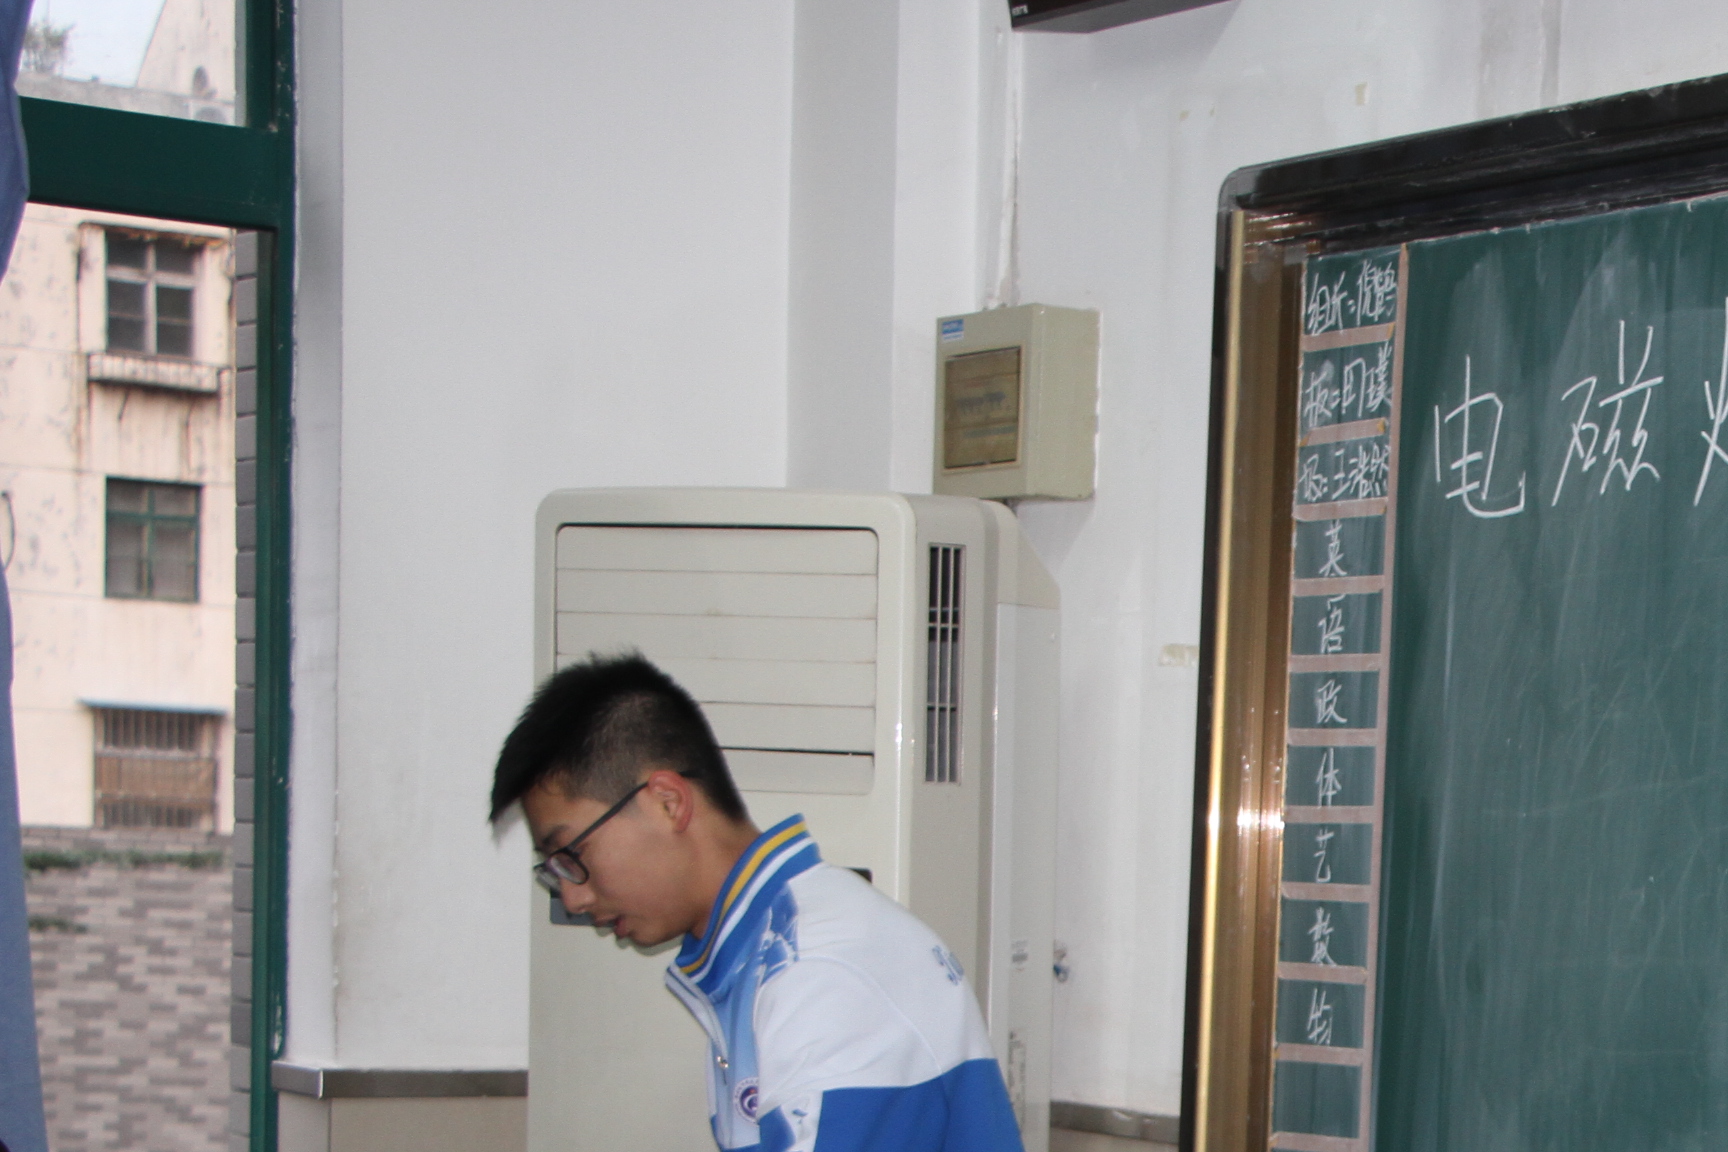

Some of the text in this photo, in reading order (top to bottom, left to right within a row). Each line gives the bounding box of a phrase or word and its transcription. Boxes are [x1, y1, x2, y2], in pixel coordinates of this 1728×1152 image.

[1315, 747, 1342, 809] 体
[1313, 827, 1335, 883] 艺
[1306, 987, 1334, 1046] 物
